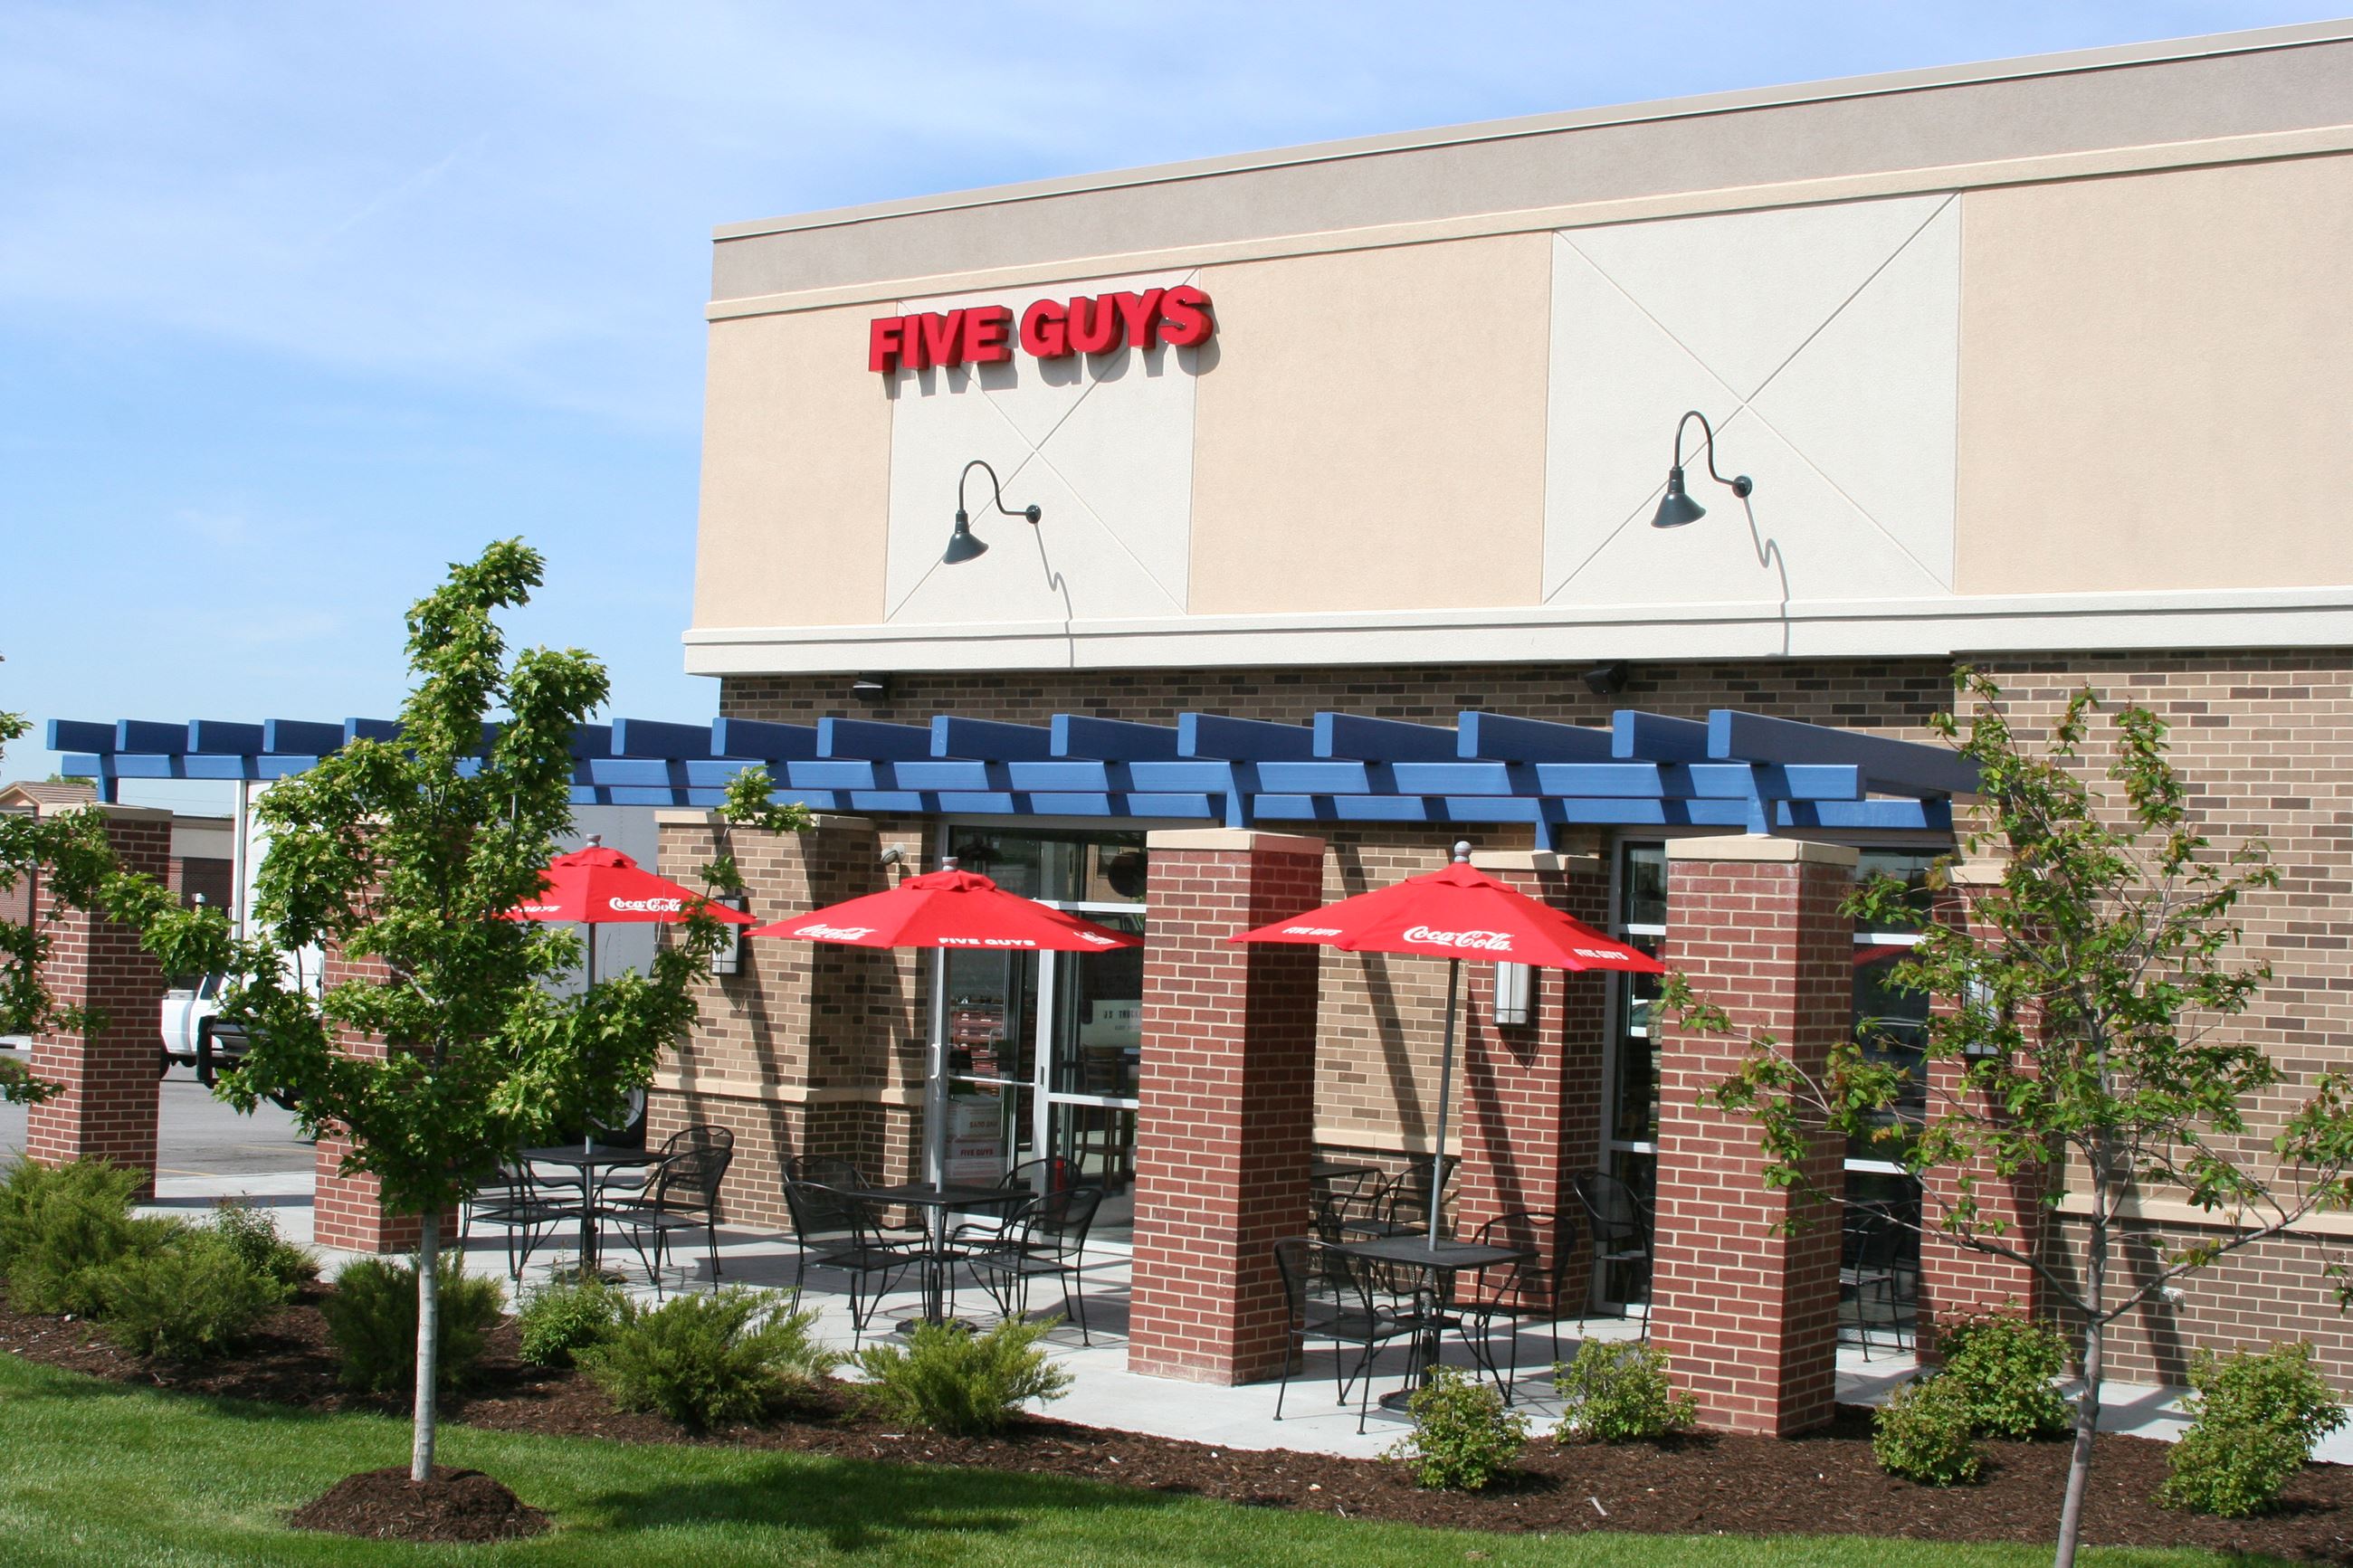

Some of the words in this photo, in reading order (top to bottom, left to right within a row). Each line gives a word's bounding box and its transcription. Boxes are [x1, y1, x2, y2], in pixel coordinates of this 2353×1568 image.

[869, 305, 1013, 373] FIVE
[1020, 285, 1214, 358] GUYS
[938, 937, 980, 946] FIVE
[985, 938, 1036, 946] GUYS
[1403, 926, 1514, 951] Coca-Cola
[1573, 948, 1600, 958] FIVE
[1595, 950, 1629, 960] GUYS
[960, 1149, 975, 1157] FIVE
[976, 1147, 994, 1156] GUYS
